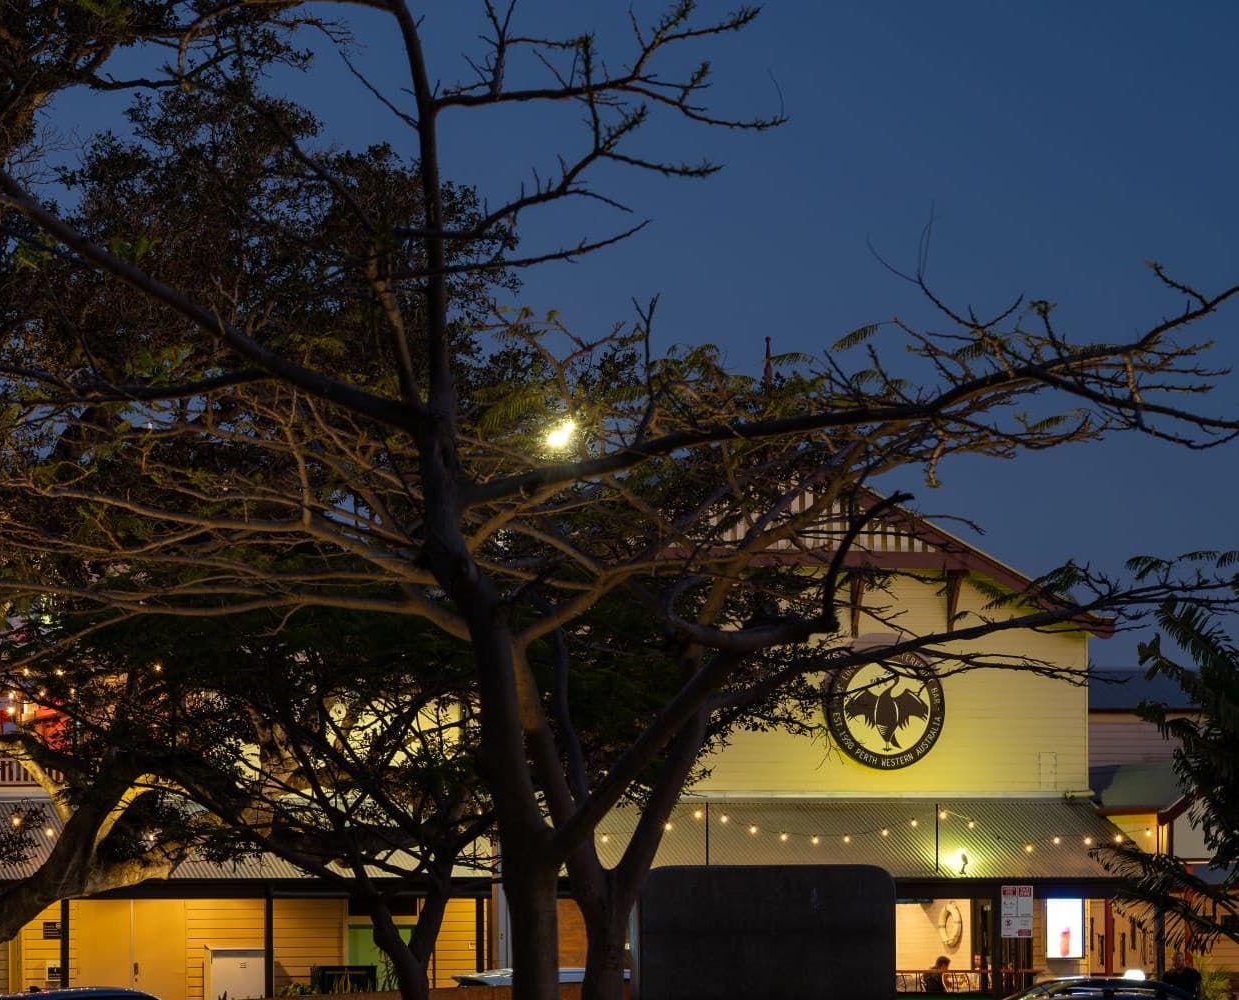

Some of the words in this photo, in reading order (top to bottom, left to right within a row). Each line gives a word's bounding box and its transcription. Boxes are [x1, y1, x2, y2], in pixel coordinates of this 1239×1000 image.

[855, 747, 878, 764] PERTH
[881, 753, 915, 767] WESTERN
[915, 716, 942, 755] AUSTRALIA
